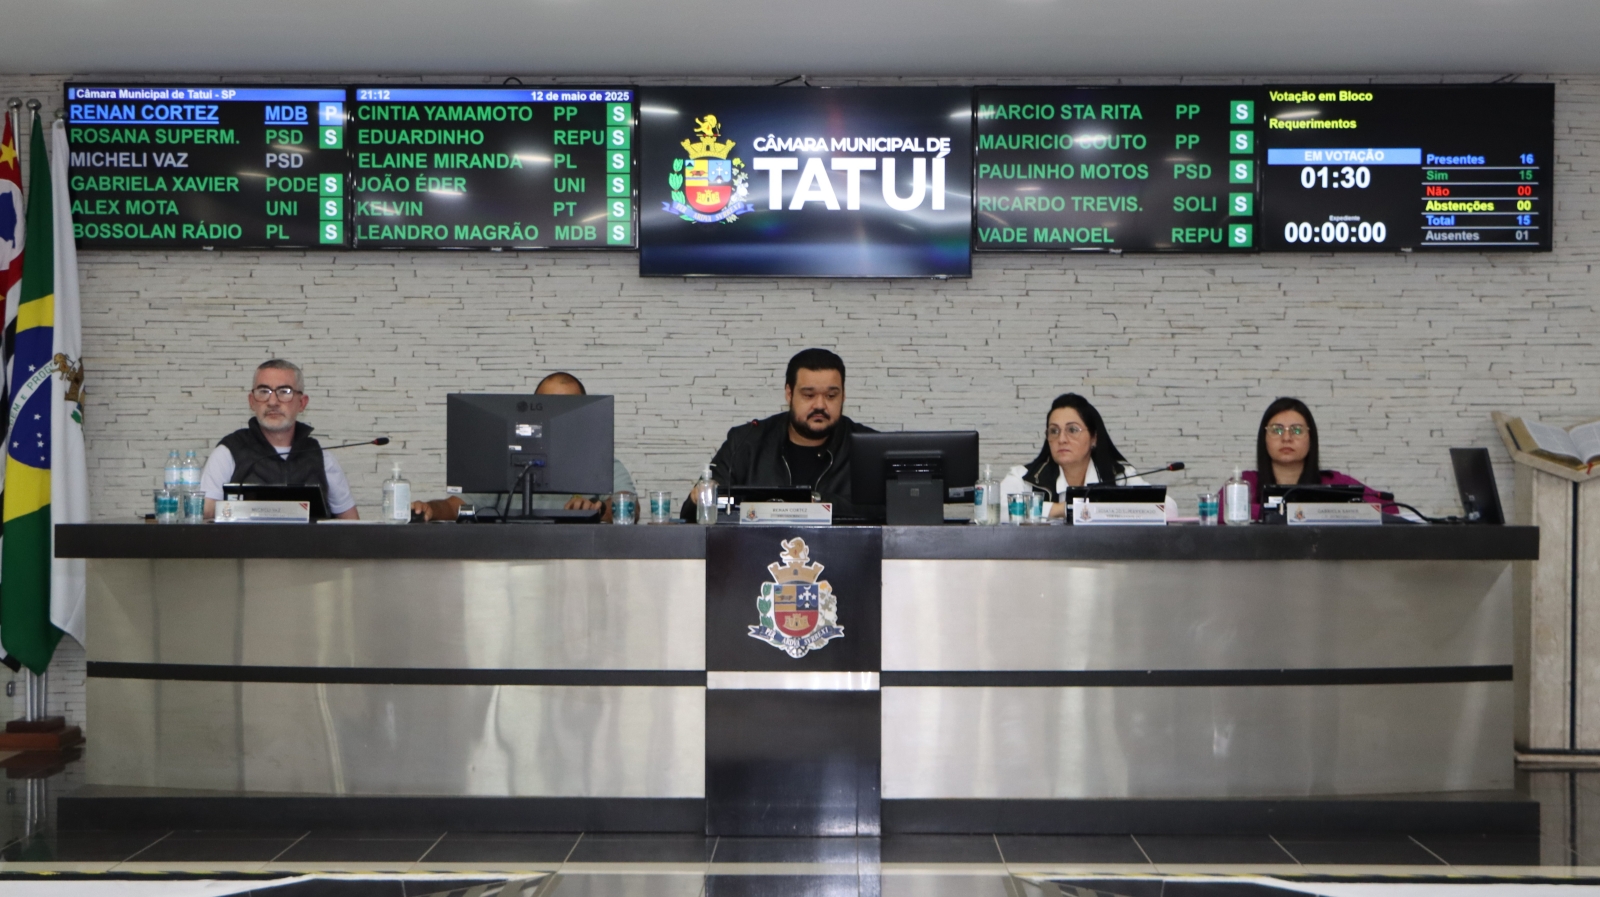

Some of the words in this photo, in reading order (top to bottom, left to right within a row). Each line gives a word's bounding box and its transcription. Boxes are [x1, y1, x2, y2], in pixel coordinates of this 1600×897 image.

[76, 88, 117, 99] Câmara
[118, 88, 169, 101] Municipal
[171, 88, 184, 99] de
[221, 89, 236, 99] SP
[360, 90, 390, 100] 21:12
[531, 91, 544, 101] 12
[546, 91, 559, 101] de
[561, 91, 587, 101] maio
[589, 91, 603, 101] de
[605, 91, 630, 101] 2025
[1269, 91, 1316, 103] Votação
[1318, 93, 1336, 102] em
[1339, 91, 1373, 102] Bloco
[70, 105, 137, 120] RENAN
[141, 105, 219, 120] CORTEZ
[265, 106, 308, 120] MDB
[325, 106, 337, 120] P
[358, 105, 420, 121] CINTIA
[424, 105, 533, 121] YAMAMOTO
[554, 106, 578, 121] PP
[613, 106, 625, 122] S
[979, 104, 1055, 120] MARCIO
[1060, 104, 1096, 120] STA
[1101, 104, 1143, 120] RITA
[1176, 104, 1200, 120] PP
[1236, 104, 1248, 120] S
[1269, 118, 1357, 131] Requerimentos
[70, 129, 150, 144] ROSANA
[155, 129, 240, 144] SUPERM.
[266, 129, 303, 144] PSD
[325, 129, 337, 144] S
[358, 129, 484, 145] EDUARDINHO
[554, 130, 604, 145] REPU
[613, 130, 625, 145] S
[753, 134, 828, 152] CÂMARA
[831, 137, 925, 152] MUNICIPAL
[927, 137, 951, 152] DE
[979, 134, 1073, 150] MAURICIO
[1080, 134, 1147, 150] COUTO
[1175, 134, 1200, 150] PP
[1235, 134, 1248, 150] S
[71, 152, 147, 168] MICHELI
[153, 153, 188, 168] VAZ
[266, 153, 304, 168] PSD
[358, 153, 427, 169] ELAINE
[434, 153, 523, 169] MIRANDA
[554, 154, 577, 169] PL
[613, 154, 625, 169] S
[1304, 151, 1322, 161] EM
[1324, 149, 1385, 163] VOTAÇÃO
[1426, 154, 1485, 165] Presentes
[1519, 154, 1534, 164] 16
[979, 164, 1074, 179] PAULINHO
[1080, 164, 1149, 179] MOTOS
[1174, 164, 1211, 179] PSD
[1235, 164, 1247, 179] S
[1301, 166, 1371, 188] 01:30
[1426, 170, 1448, 180] Sim
[1519, 170, 1533, 180] 15
[71, 176, 169, 192] GABRIELA
[172, 177, 239, 192] XAVIER
[266, 177, 318, 192] PODE
[325, 177, 337, 193] S
[357, 173, 410, 193] JOÃO
[415, 173, 467, 193] ÉDER
[554, 177, 585, 193] UNI
[613, 177, 625, 193] S
[753, 151, 951, 211] TATUÍ
[1426, 186, 1449, 197] Não
[1517, 186, 1532, 196] 00
[71, 200, 121, 215] ALEX
[125, 200, 179, 215] MOTA
[266, 200, 298, 216] UNI
[325, 201, 337, 216] S
[357, 201, 423, 217] KELVIN
[553, 202, 577, 217] PT
[613, 201, 625, 217] S
[979, 196, 1065, 212] RICARDO
[1071, 196, 1143, 212] TREVIS.
[1173, 196, 1217, 212] SOLI
[1234, 196, 1247, 212] S
[1425, 200, 1494, 213] Abstenções
[1517, 201, 1531, 211] 00
[1426, 215, 1455, 226] Total
[1516, 215, 1531, 226] 15
[73, 224, 177, 239] BOSSOLAN
[183, 220, 242, 239] RÁDIO
[266, 224, 289, 239] PL
[325, 224, 337, 240] S
[357, 225, 448, 240] LEANDRO
[454, 221, 539, 240] MAGRÃO
[555, 225, 597, 240] MDB
[613, 225, 625, 241] S
[978, 227, 1027, 243] VADE
[1034, 227, 1114, 243] MANOEL
[1171, 227, 1222, 243] REPU
[1234, 227, 1247, 243] S
[1284, 222, 1386, 243] 00:00:00
[1425, 230, 1480, 241] Ausentes
[1515, 230, 1529, 241] 01
[530, 402, 543, 411] LG
